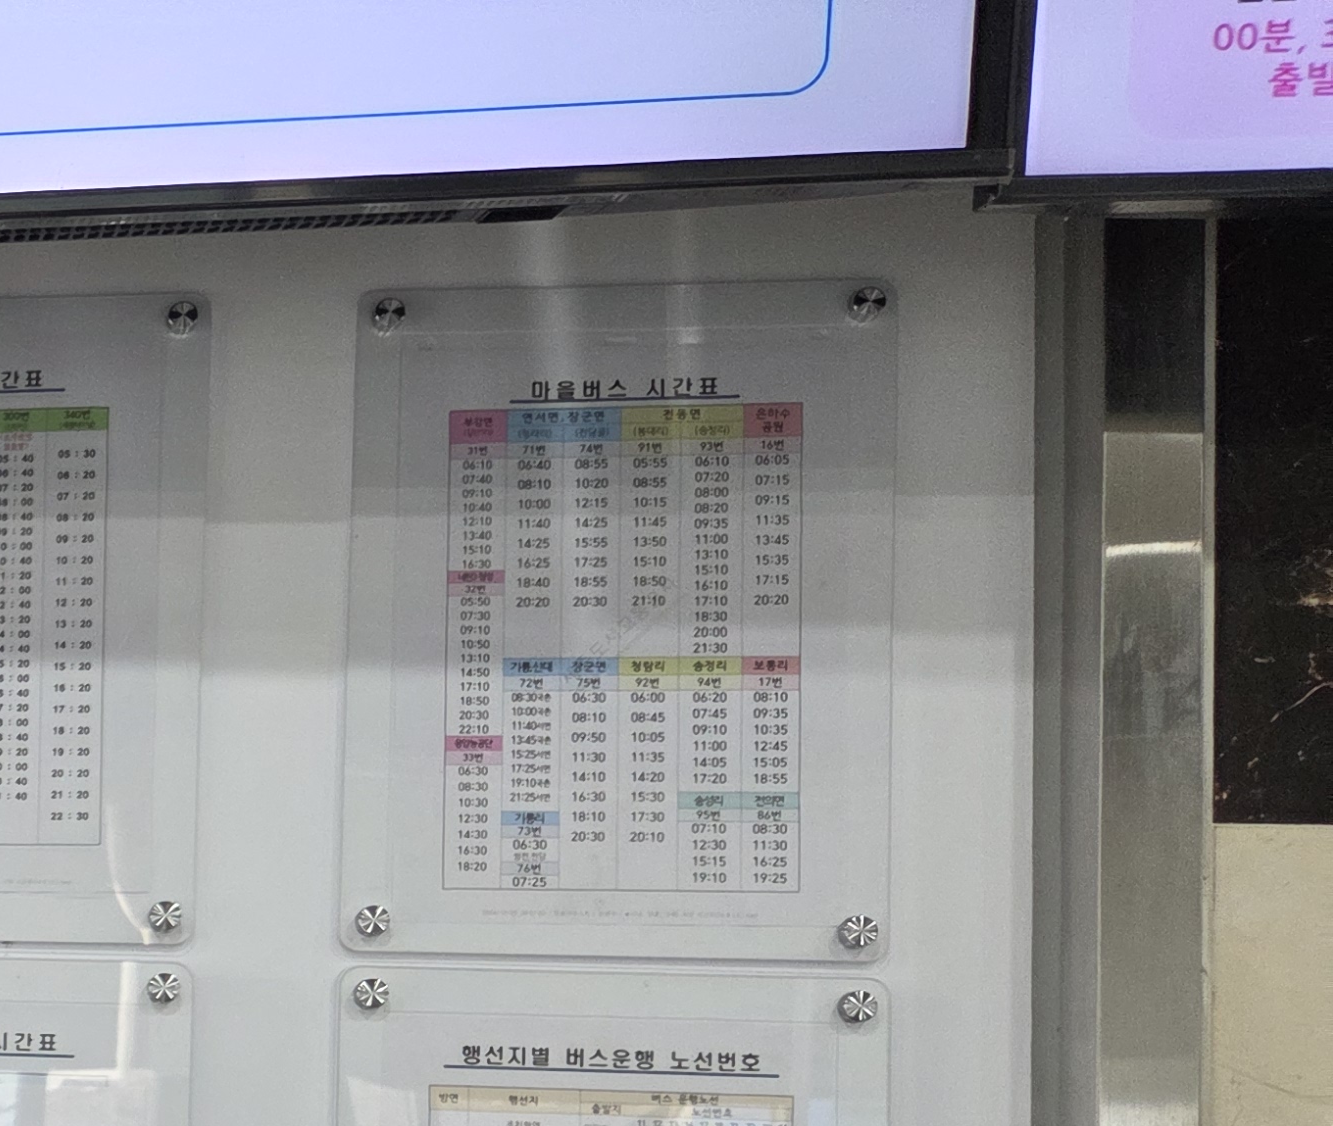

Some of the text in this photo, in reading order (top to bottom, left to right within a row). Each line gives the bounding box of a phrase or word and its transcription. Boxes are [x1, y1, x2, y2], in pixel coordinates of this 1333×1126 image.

[531, 377, 723, 401] 마을버스 시간표
[571, 453, 790, 474] 08:55 05:55 06:10 06:05
[462, 1045, 761, 1073] 행선지별 버스운행 노선번호
